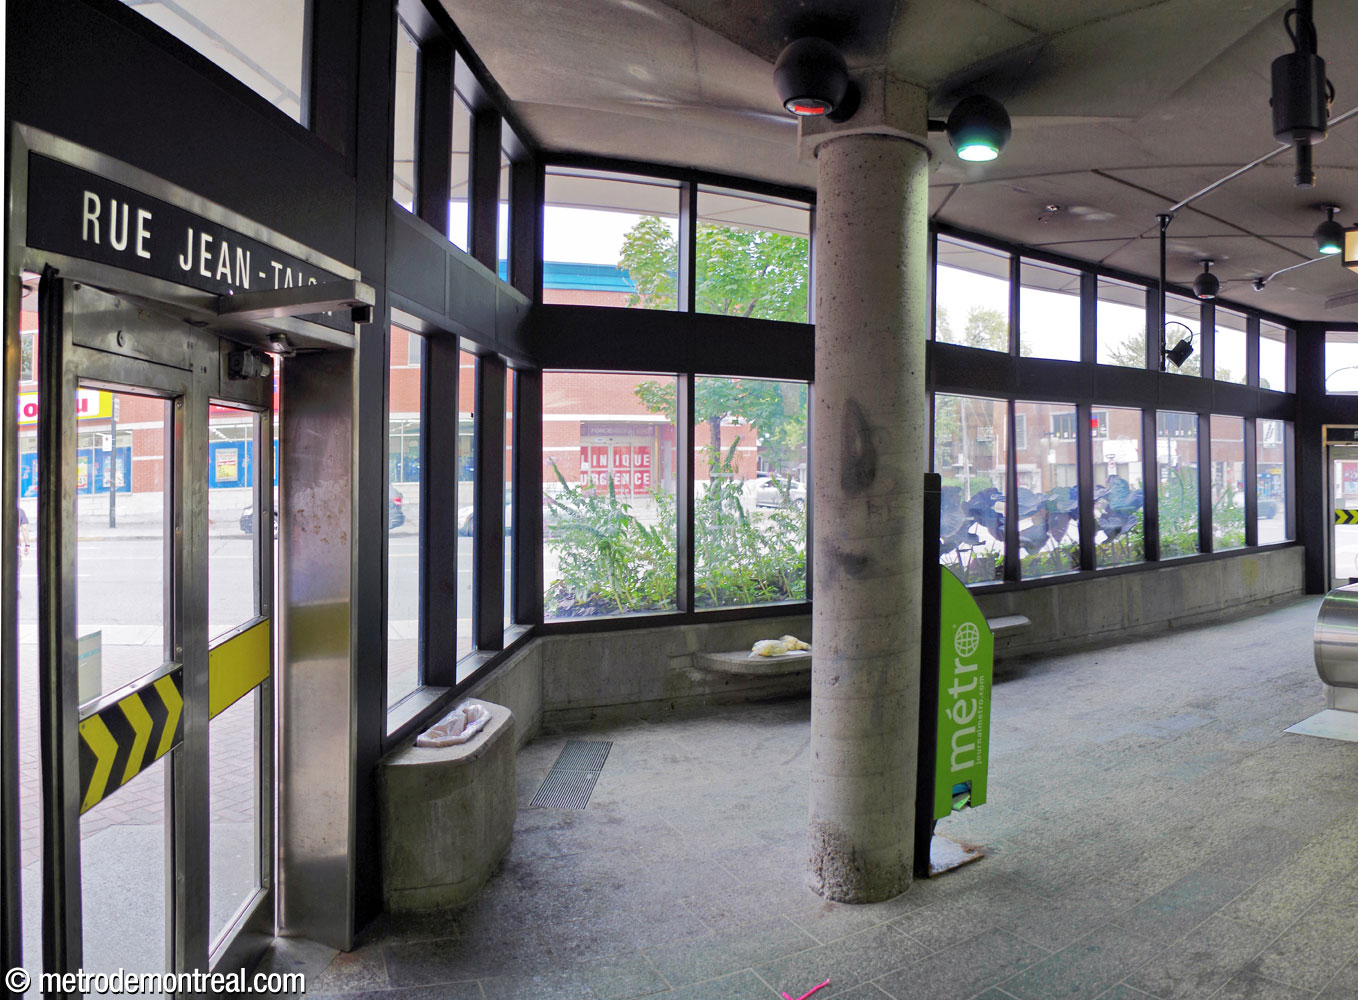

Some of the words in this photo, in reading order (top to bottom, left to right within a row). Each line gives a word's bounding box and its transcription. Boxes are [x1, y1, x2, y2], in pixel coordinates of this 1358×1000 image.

[82, 189, 152, 259] RUE
[179, 227, 326, 290] JEAN-TA
[581, 454, 650, 466] LINIQUE
[580, 472, 650, 485] URGENCE
